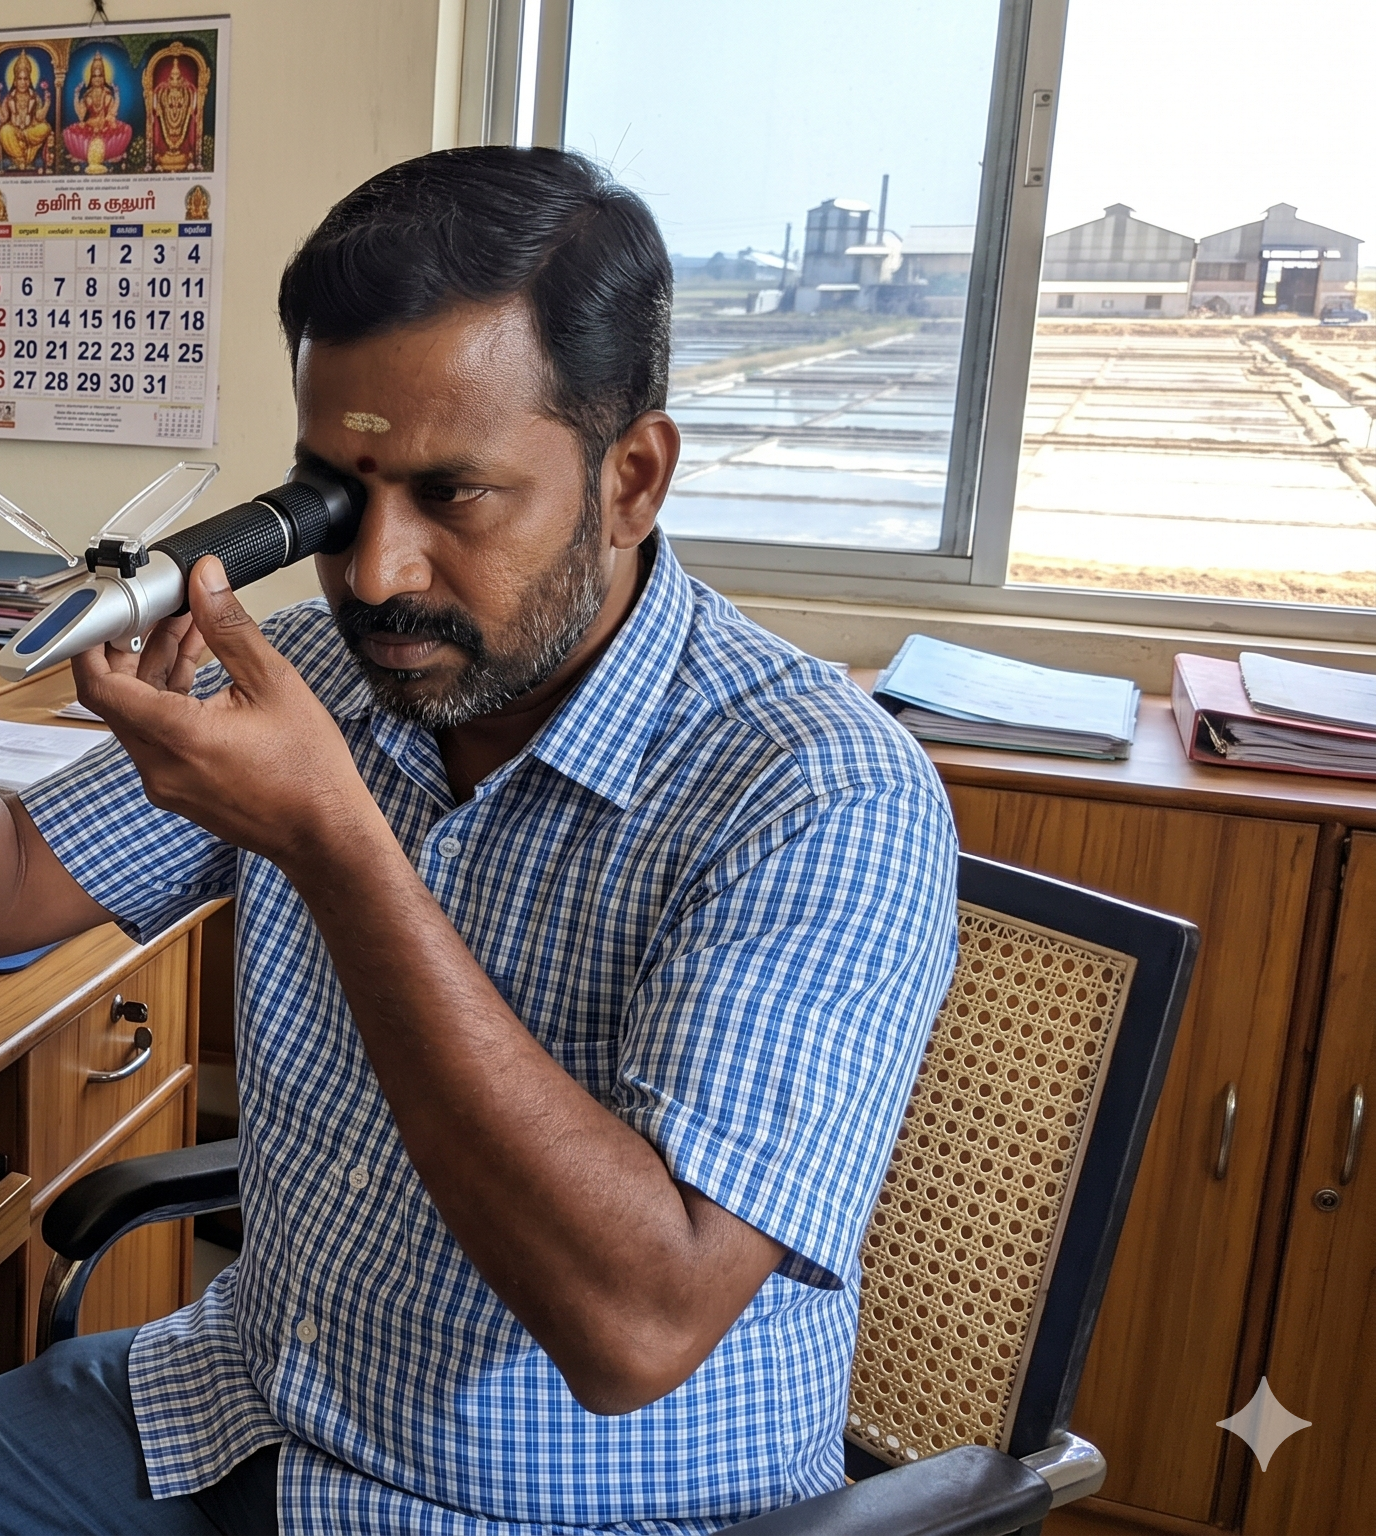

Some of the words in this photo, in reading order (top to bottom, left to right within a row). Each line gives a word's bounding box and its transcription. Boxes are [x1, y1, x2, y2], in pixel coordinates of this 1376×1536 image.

[86, 244, 96, 265] 1
[119, 244, 132, 264] 2
[153, 244, 166, 265] 3
[187, 243, 201, 264] 4
[21, 276, 33, 297] 6
[53, 277, 66, 297] 7
[85, 277, 98, 297] 8
[118, 277, 130, 298] 9
[147, 277, 172, 298] 10
[181, 277, 205, 298] 11
[15, 308, 38, 328] 13
[47, 308, 71, 328] 14
[79, 309, 103, 329] 15
[112, 309, 136, 330] 16
[146, 309, 171, 330] 17
[180, 310, 205, 331] 18
[13, 339, 38, 359] 20
[45, 340, 68, 360] 21
[77, 341, 102, 361] 22
[110, 341, 135, 362] 23
[144, 342, 170, 362] 24
[177, 342, 204, 363] 25
[13, 370, 37, 390] 27
[44, 371, 69, 391] 28
[76, 372, 101, 392] 29
[109, 373, 134, 394] 30
[143, 374, 166, 395] 31
